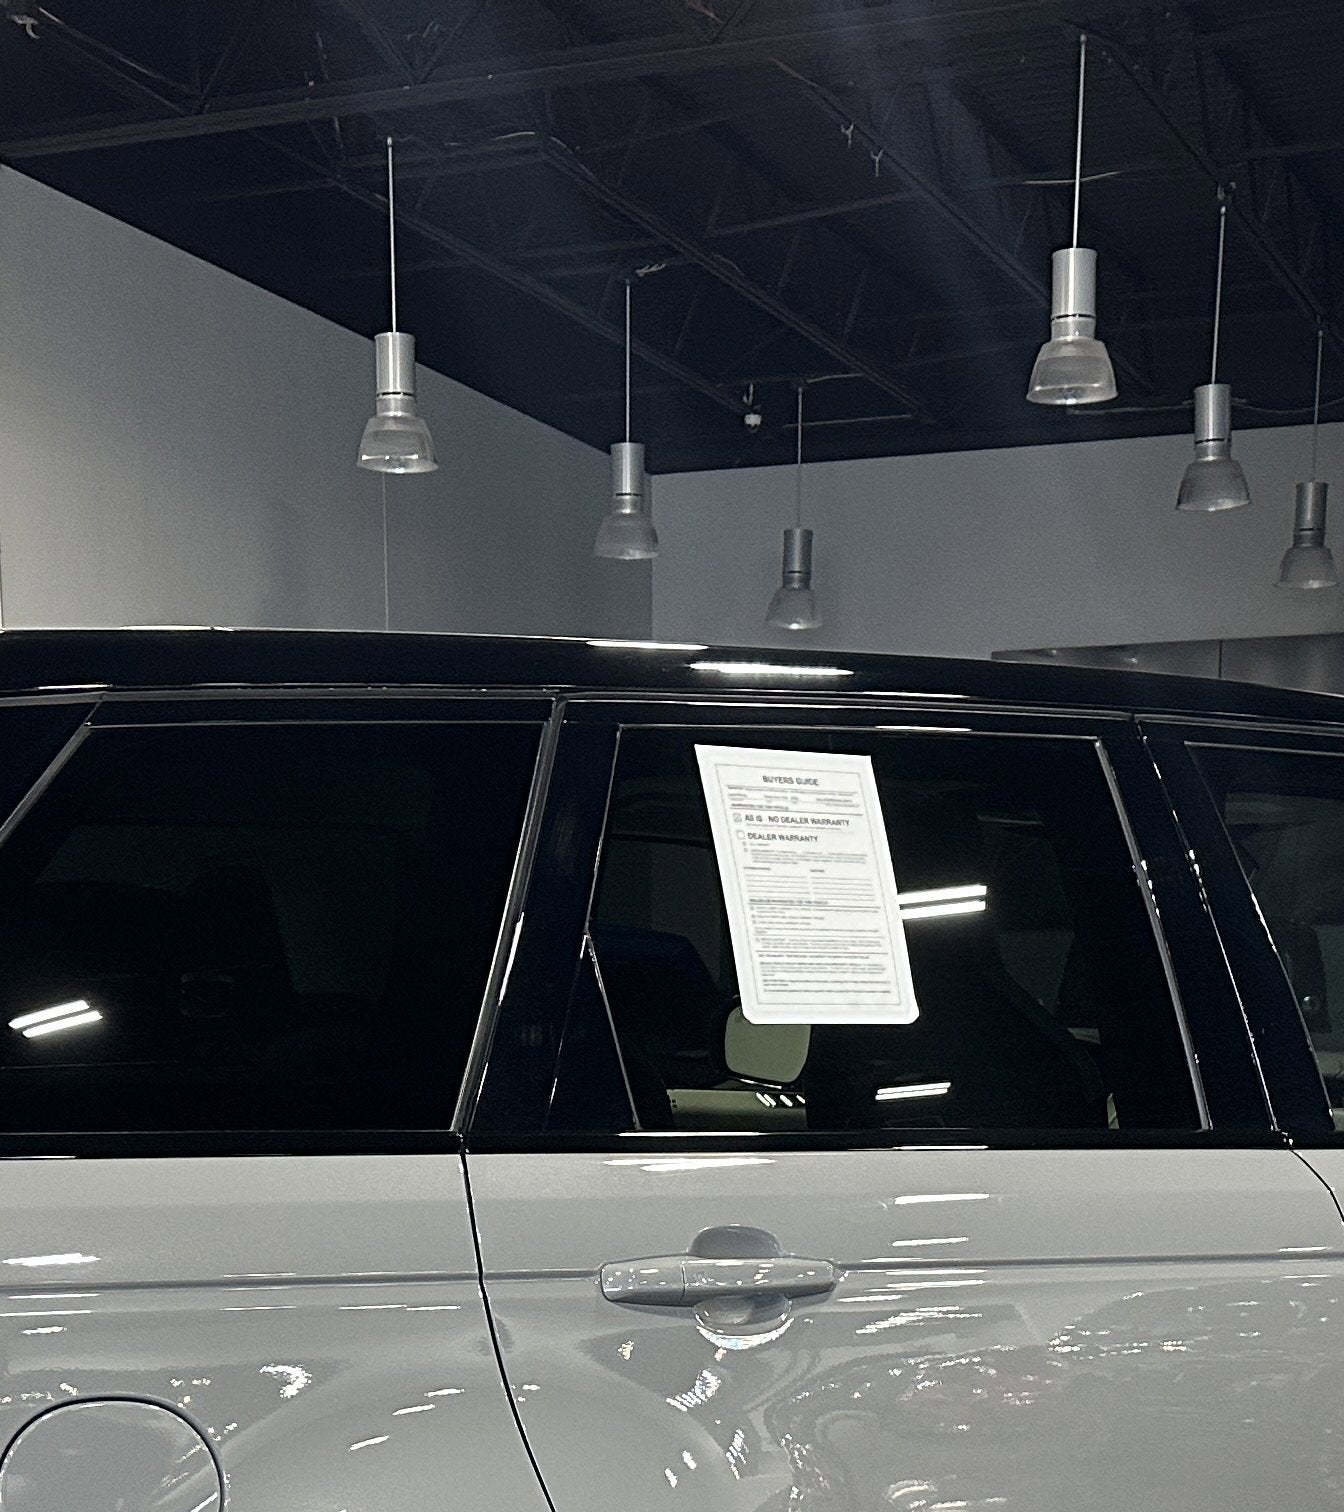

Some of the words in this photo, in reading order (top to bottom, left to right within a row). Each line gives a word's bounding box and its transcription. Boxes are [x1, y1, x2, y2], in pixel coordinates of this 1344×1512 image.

[762, 775, 794, 785] BUYERS
[796, 776, 819, 787] GUIDE
[768, 815, 779, 824] NO
[780, 816, 809, 825] DEALER
[810, 817, 850, 827] WARRANTY
[747, 832, 777, 841] DEALER
[778, 833, 819, 843] WARRANTY
